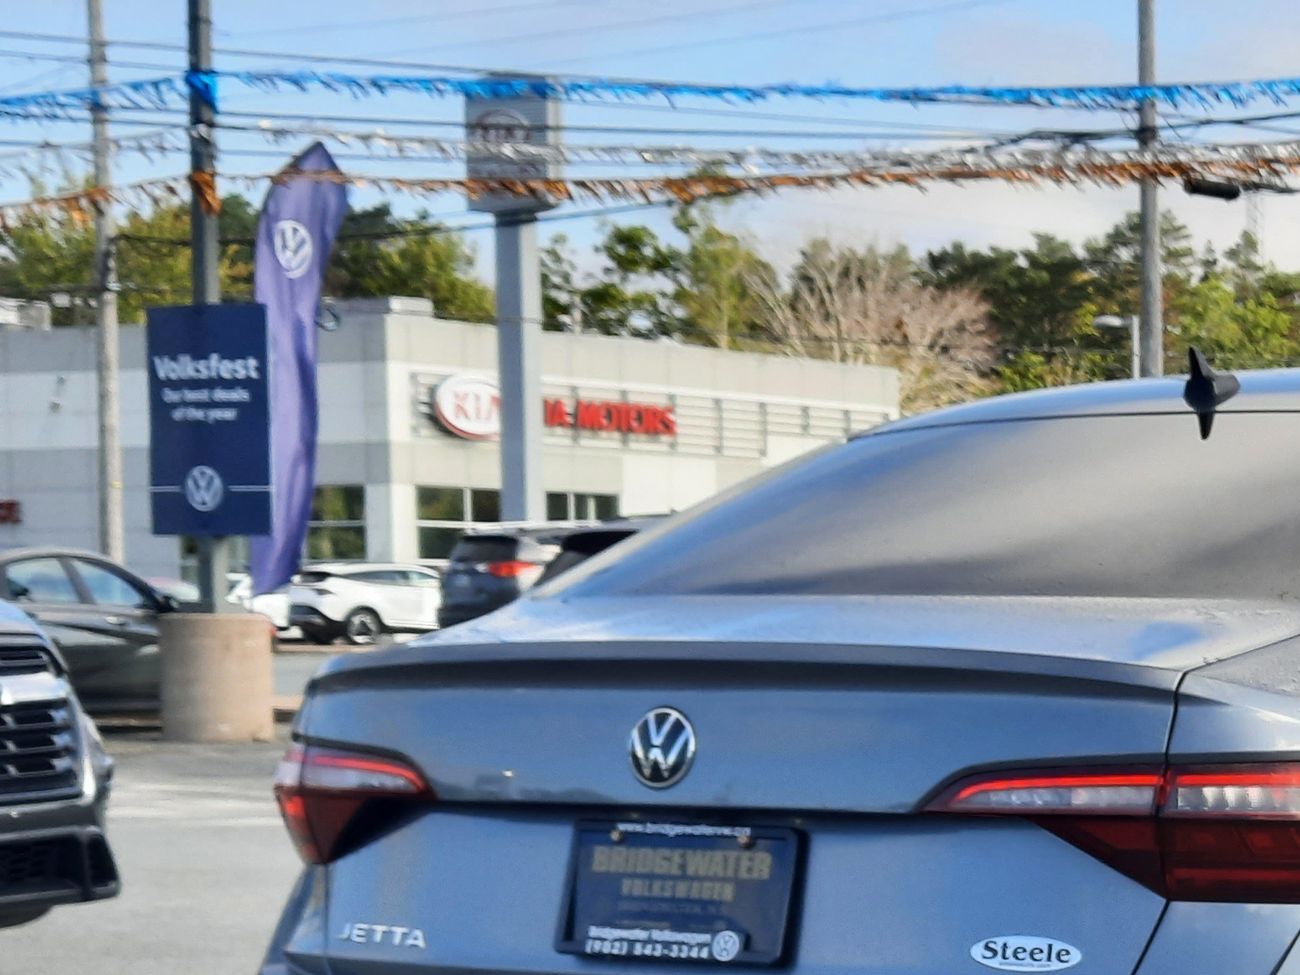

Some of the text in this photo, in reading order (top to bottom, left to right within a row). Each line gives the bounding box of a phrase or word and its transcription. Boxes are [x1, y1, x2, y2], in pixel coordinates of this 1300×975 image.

[153, 353, 260, 380] Volksfest
[577, 398, 677, 436] MOTORS
[592, 845, 773, 879] BRIDGEWATER
[621, 877, 736, 901] VOLKSWAGEN
[336, 923, 426, 949] JETTA
[633, 942, 711, 959] 543-3344
[981, 940, 1072, 964] Steele
